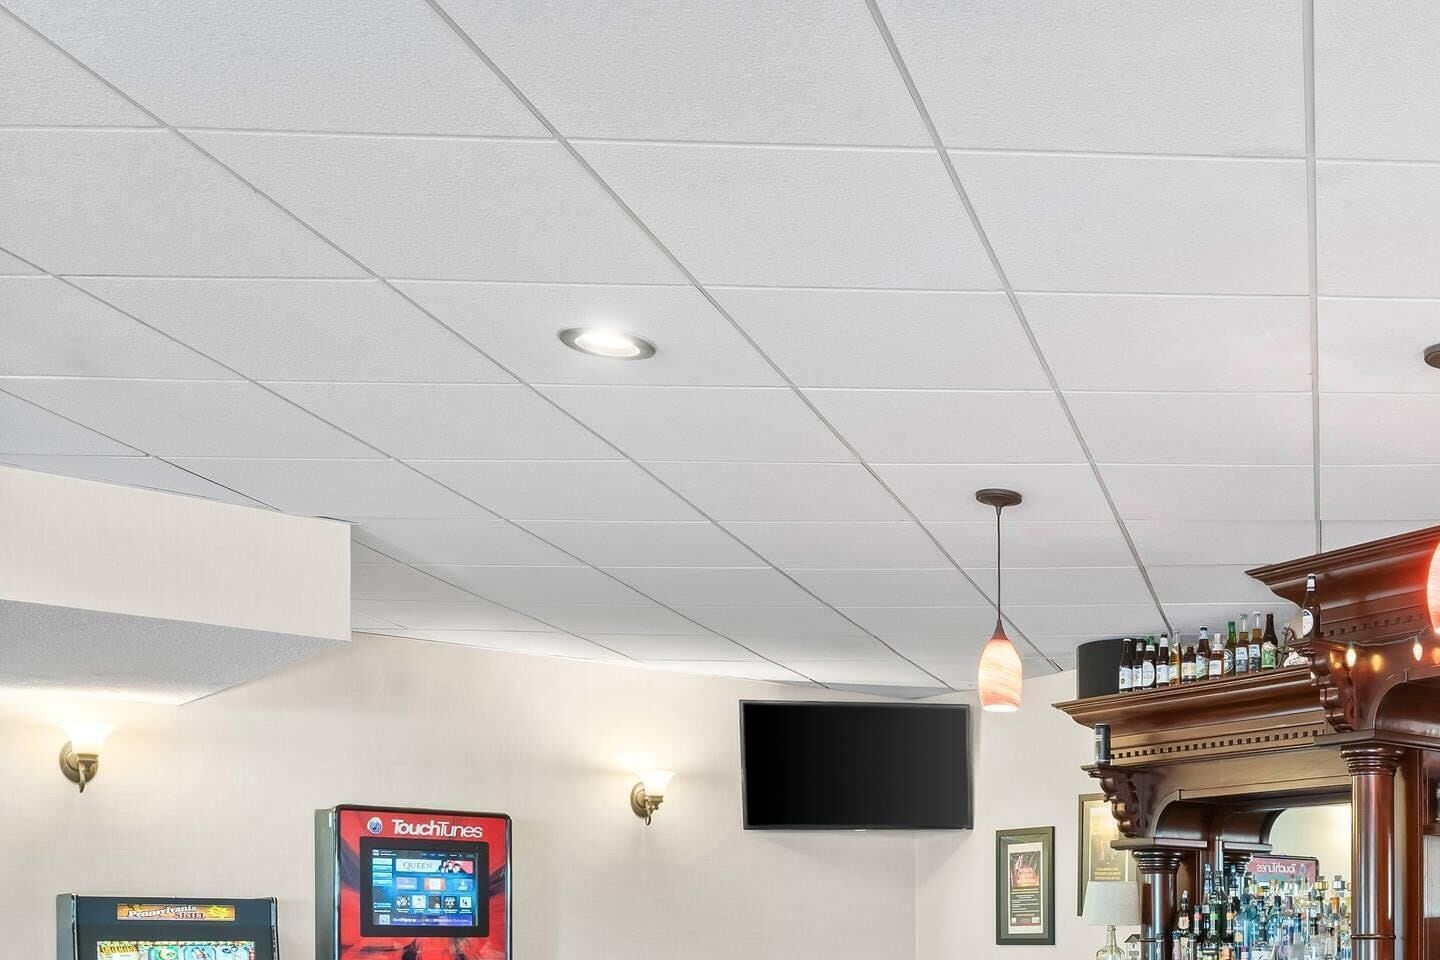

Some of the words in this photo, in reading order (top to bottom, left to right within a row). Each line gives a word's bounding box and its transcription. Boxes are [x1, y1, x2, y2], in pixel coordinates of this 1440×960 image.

[391, 818, 484, 838] TouchTunes
[403, 860, 434, 871] QUEEN
[128, 904, 197, 918] Pennsylvania
[174, 912, 206, 920] SKILL
